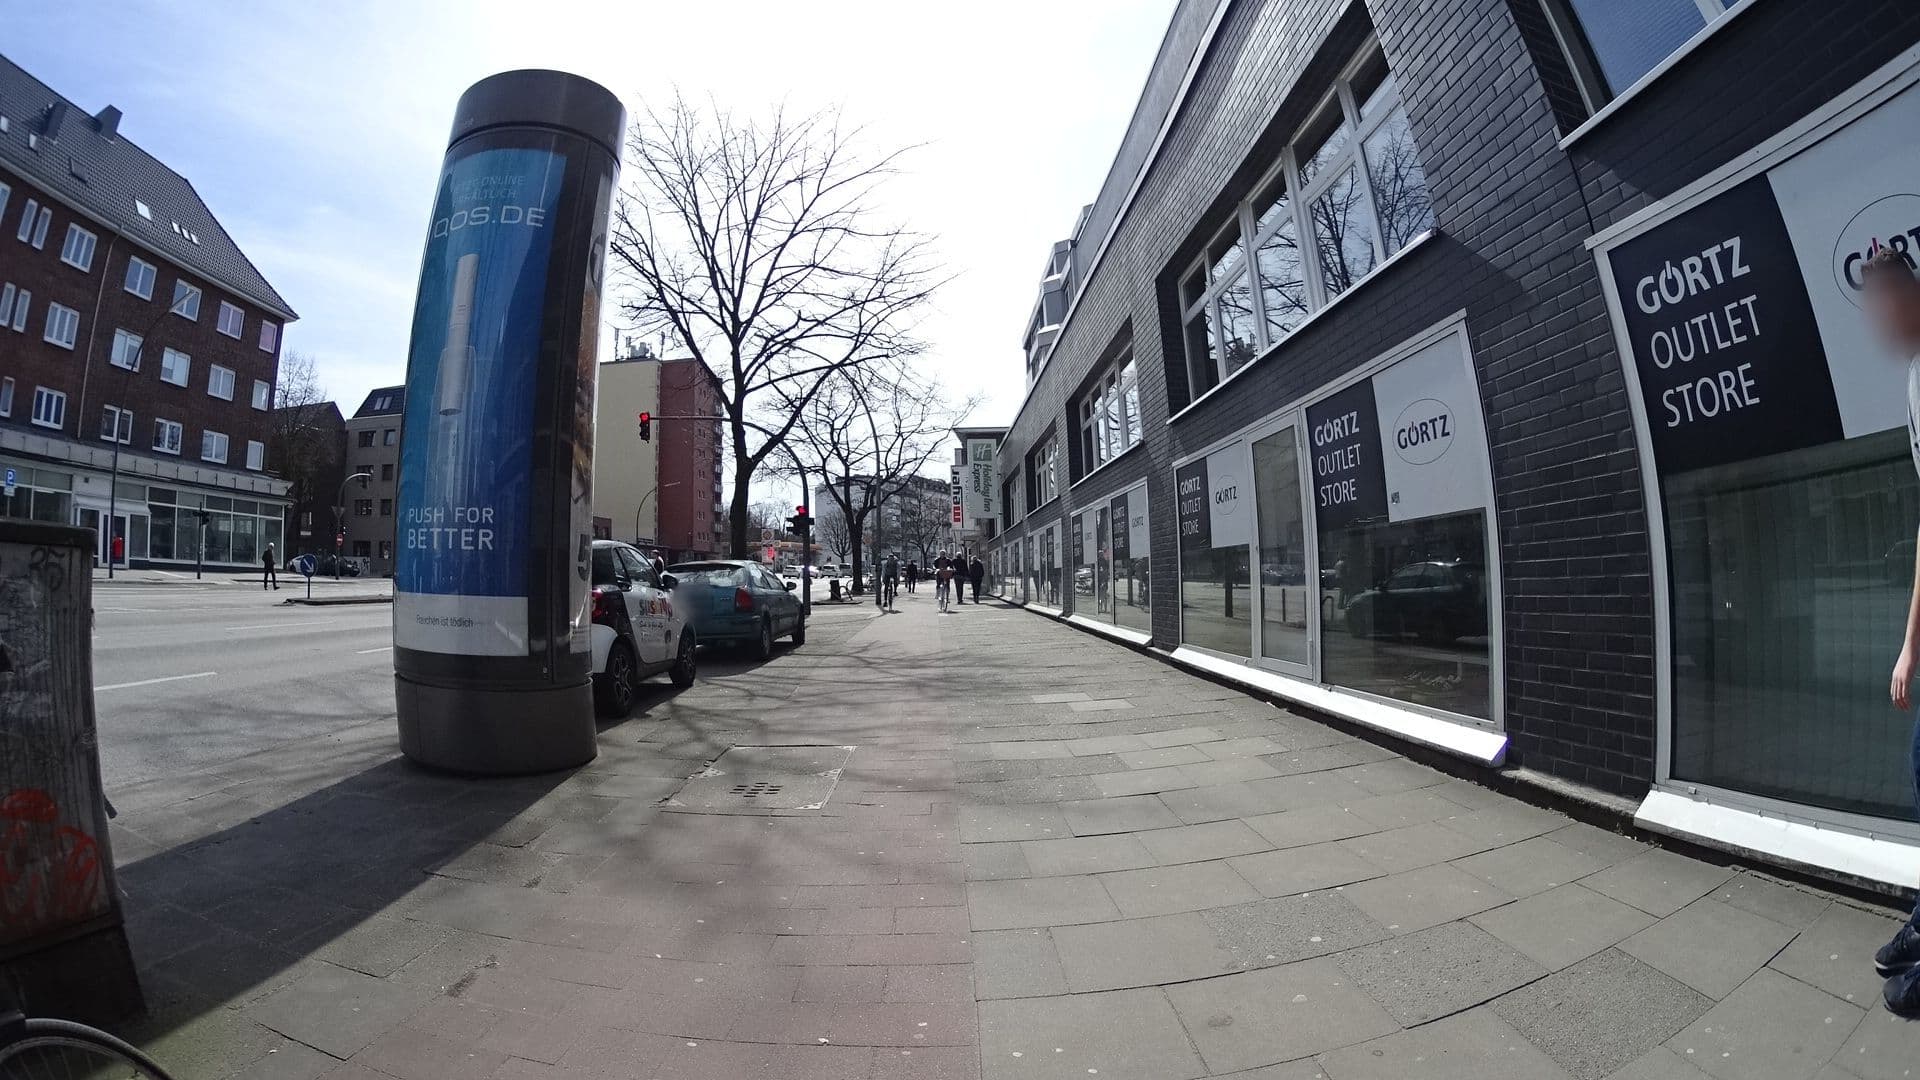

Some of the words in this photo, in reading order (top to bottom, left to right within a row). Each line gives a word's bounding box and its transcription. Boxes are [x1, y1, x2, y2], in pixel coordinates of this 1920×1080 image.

[1651, 294, 1761, 369] OUTLET
[1662, 363, 1760, 428] STORE
[1318, 443, 1361, 476] OUTLET
[972, 463, 981, 493] Express
[981, 464, 992, 498] Holiday
[1320, 478, 1357, 507] STORE
[408, 507, 444, 523] PUSH
[455, 507, 494, 523] FOR
[983, 498, 993, 512] Inn
[1181, 497, 1201, 516] OUTLET
[407, 528, 494, 550] BETTER
[1182, 519, 1199, 536] STORE
